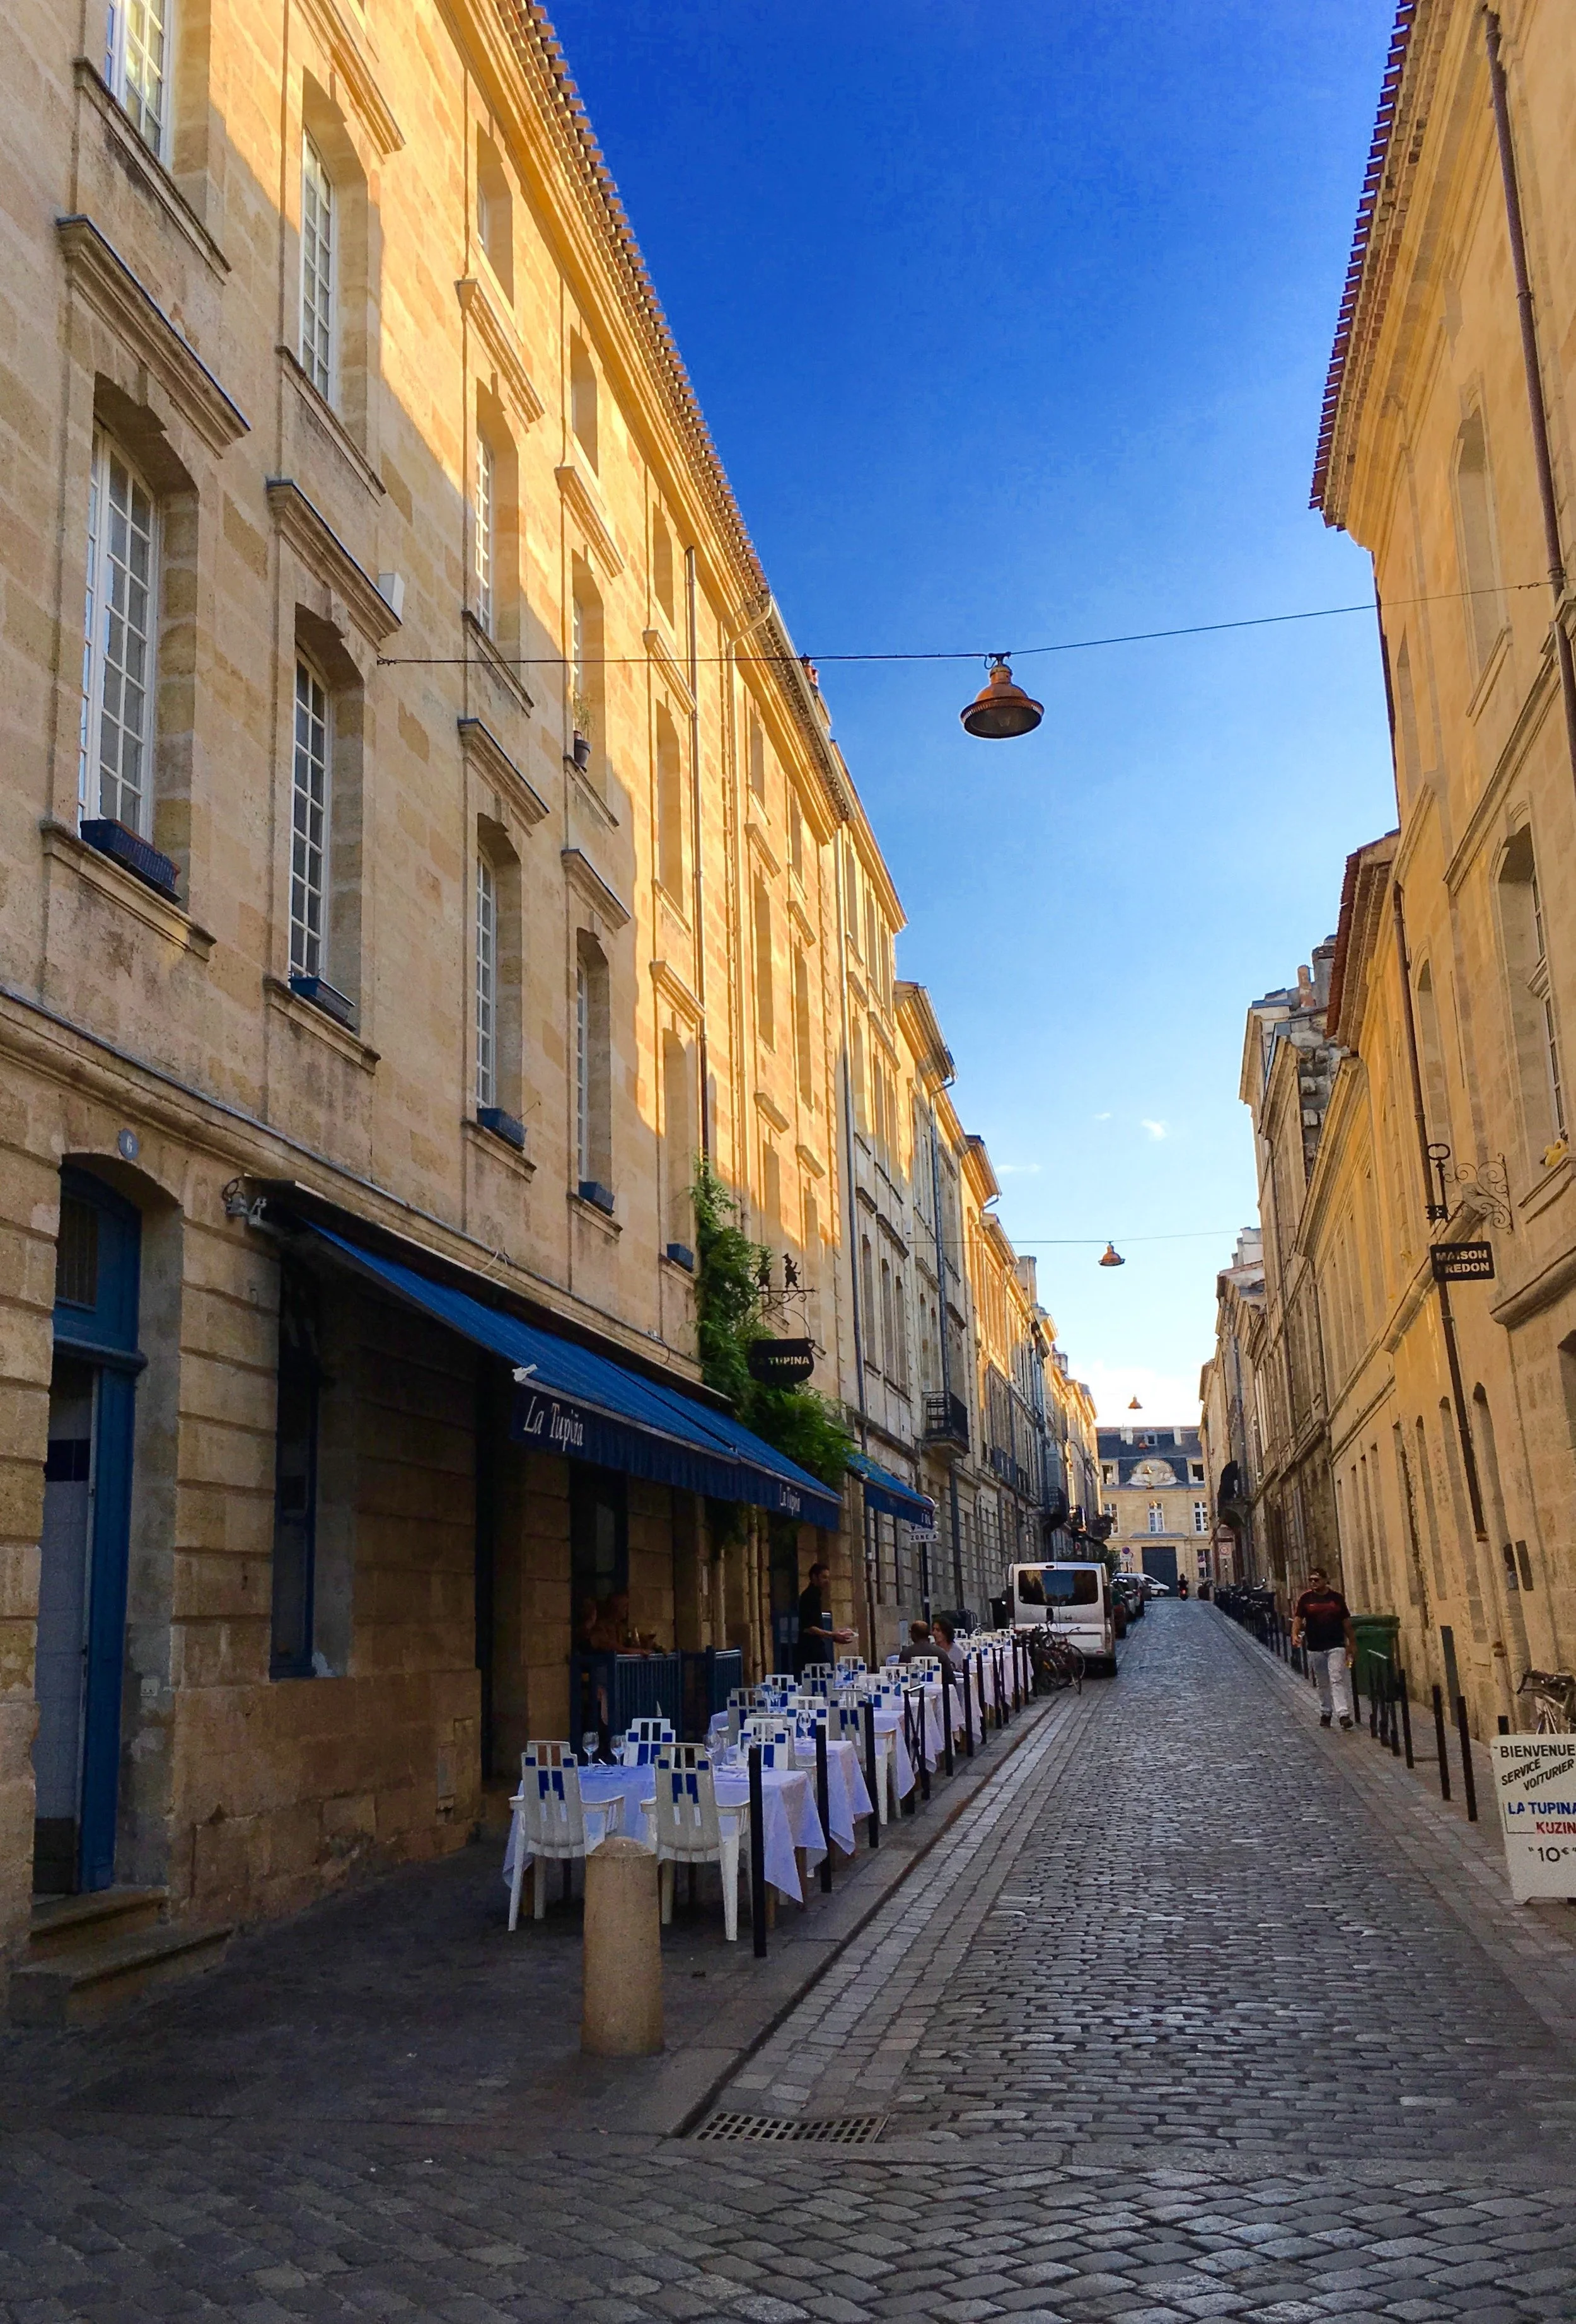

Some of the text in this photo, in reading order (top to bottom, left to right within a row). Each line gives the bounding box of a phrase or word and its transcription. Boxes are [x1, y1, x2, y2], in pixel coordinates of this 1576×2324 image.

[126, 1136, 133, 1153] 6
[1437, 1262, 1490, 1273] REDON
[523, 1396, 544, 1434] La
[1502, 1758, 1541, 1786] SERVICE
[1523, 1758, 1574, 1791] VOITURIER
[1508, 1802, 1525, 1815] LA
[1536, 1821, 1576, 1834] KUZIN
